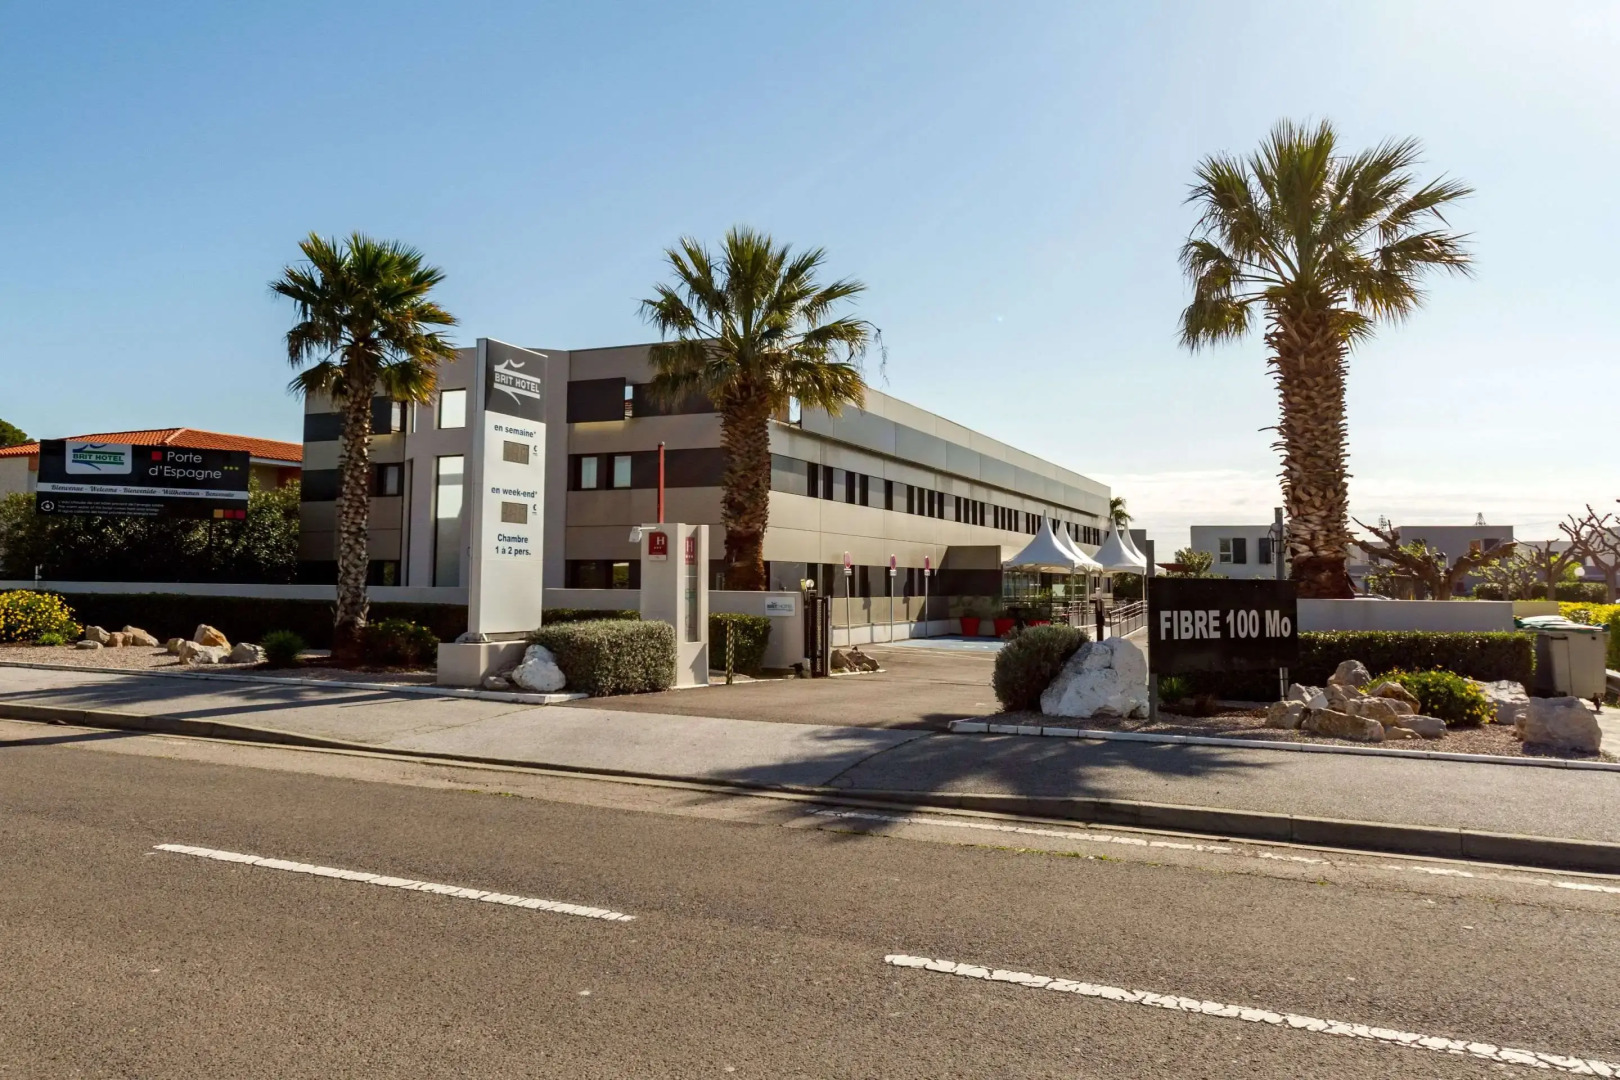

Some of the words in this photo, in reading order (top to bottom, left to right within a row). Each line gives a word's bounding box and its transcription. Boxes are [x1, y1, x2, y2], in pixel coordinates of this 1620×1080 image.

[494, 372, 514, 386] BRIT
[515, 377, 540, 393] HOTEL
[494, 423, 504, 432] en
[95, 453, 124, 462] HOTEL
[167, 451, 203, 464] Porte
[148, 465, 222, 481] d'Espagne
[90, 485, 118, 493] Welcome
[491, 486, 501, 494] en
[497, 533, 529, 544] Chambre
[495, 546, 499, 554] 1
[501, 546, 506, 554] à
[507, 546, 513, 554] 2
[514, 547, 532, 557] pers.
[1160, 610, 1221, 640] FIBRE
[1226, 609, 1259, 638] 100
[1265, 609, 1291, 638] Mo
